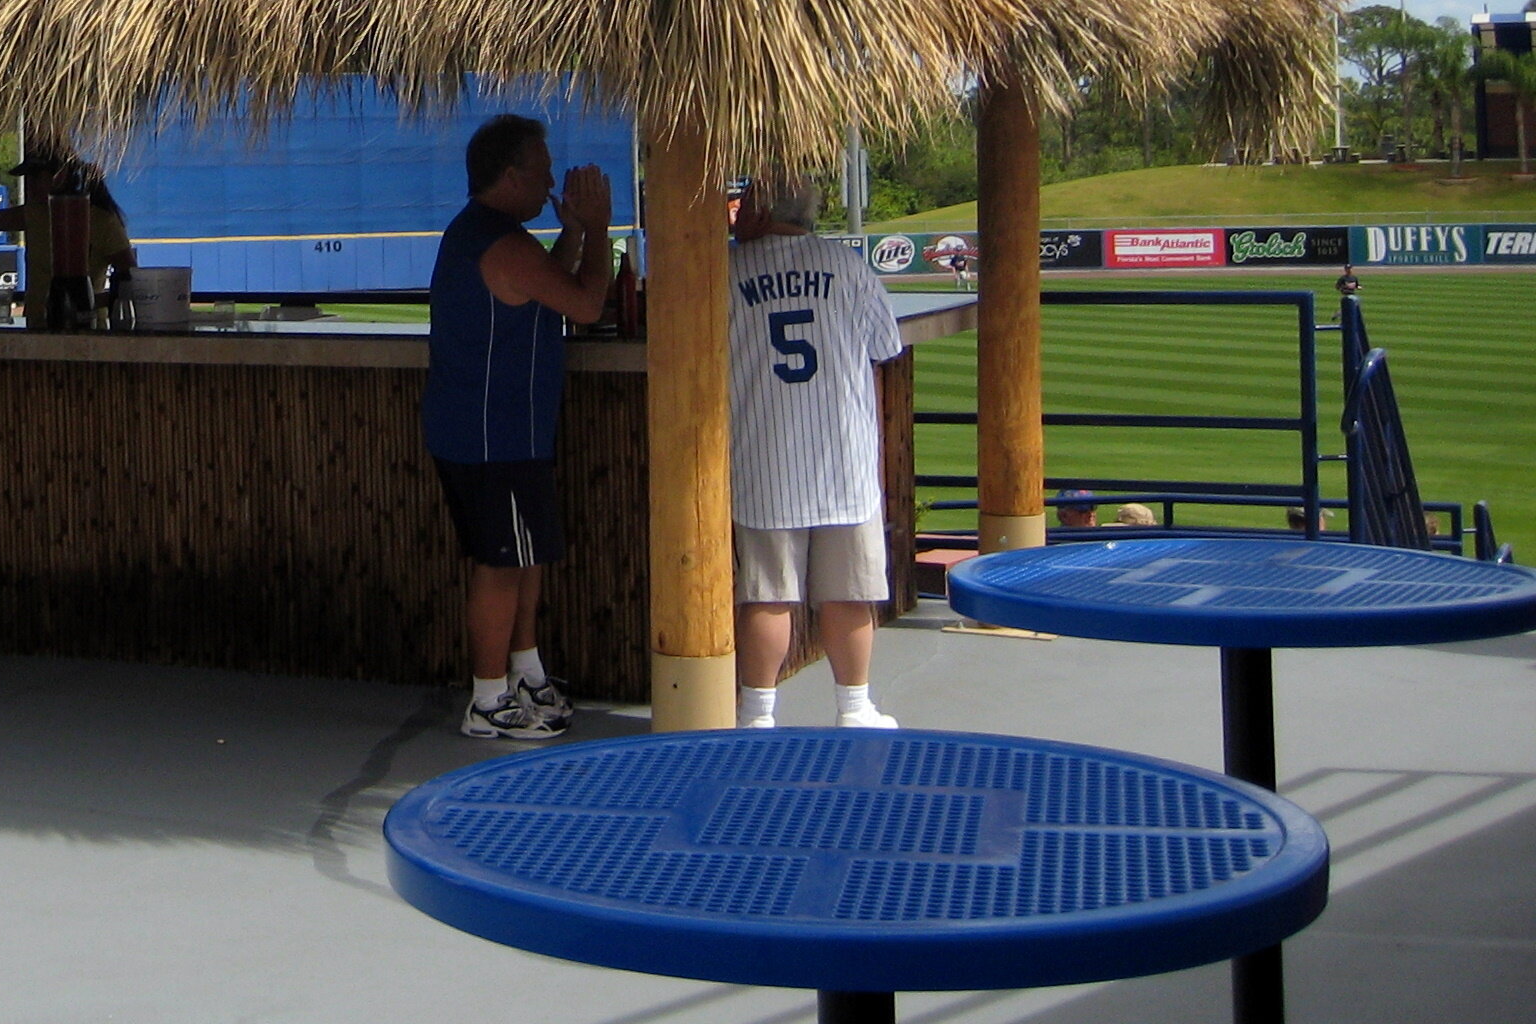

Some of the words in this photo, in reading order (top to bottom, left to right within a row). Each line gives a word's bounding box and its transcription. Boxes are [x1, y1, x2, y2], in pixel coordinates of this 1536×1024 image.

[314, 240, 342, 253] 410
[878, 244, 912, 263] Lite
[1230, 231, 1307, 263] Grolsch
[739, 270, 835, 307] WRIGHT
[768, 309, 818, 384] 5
